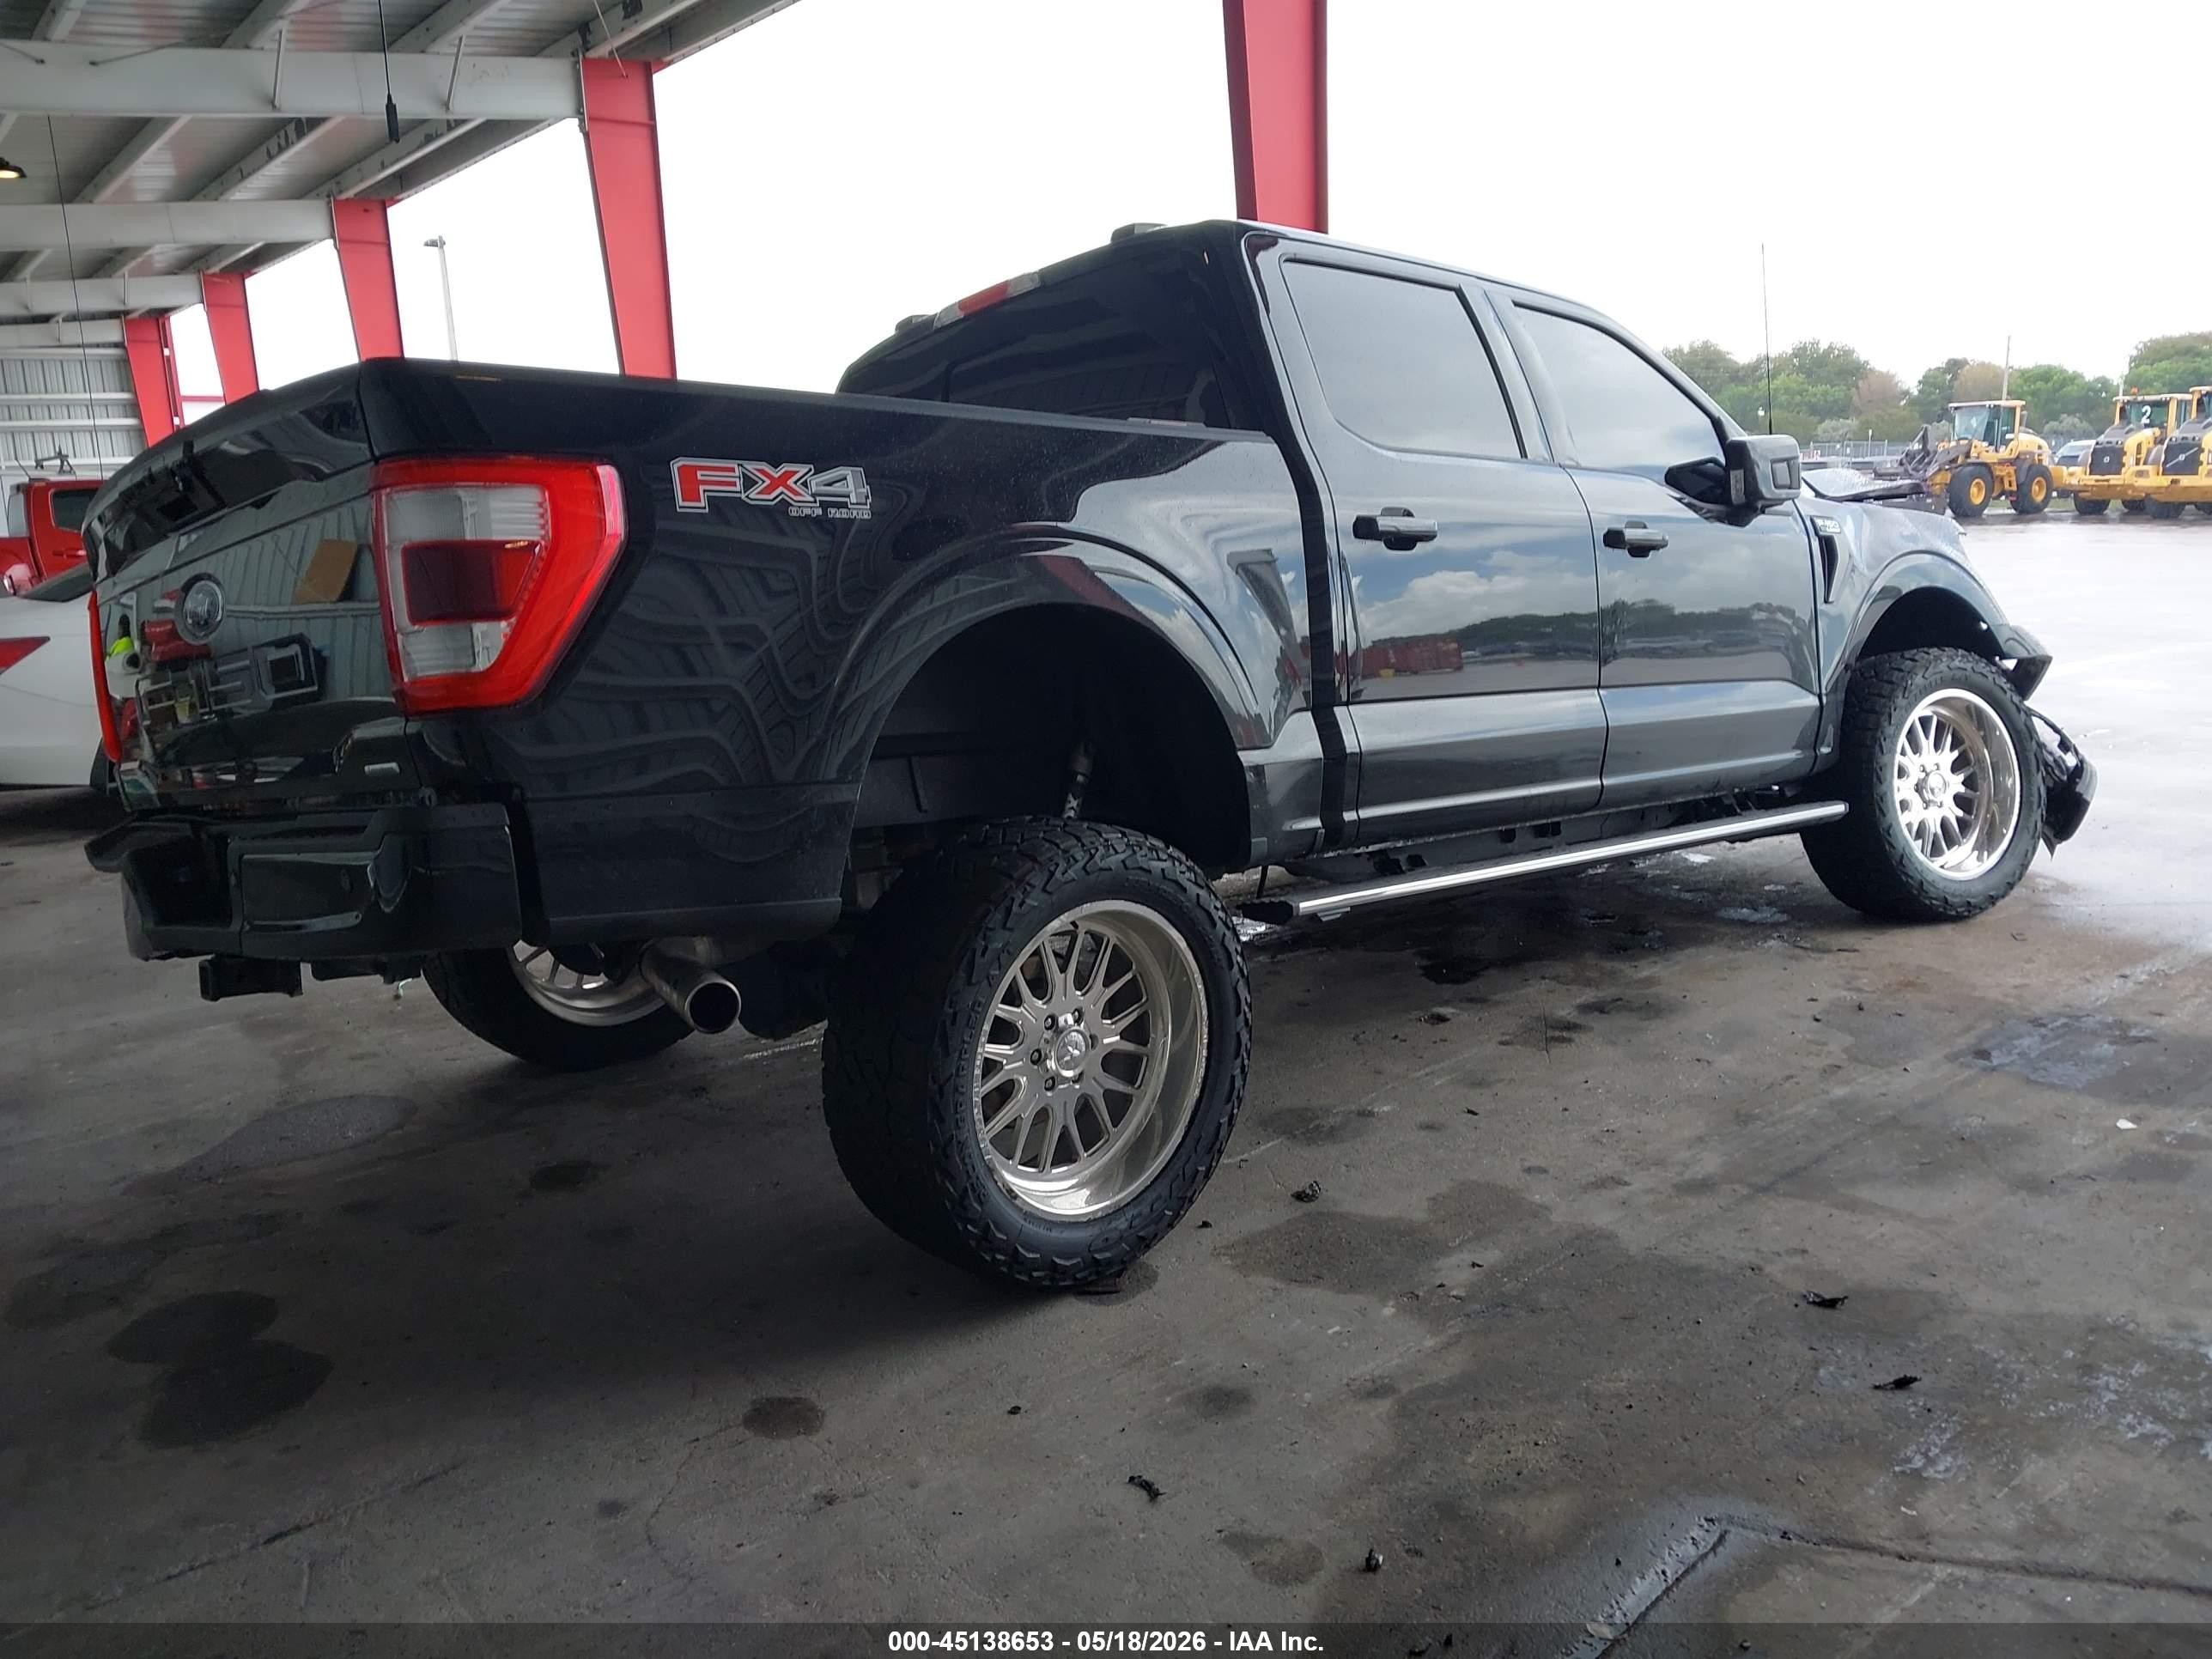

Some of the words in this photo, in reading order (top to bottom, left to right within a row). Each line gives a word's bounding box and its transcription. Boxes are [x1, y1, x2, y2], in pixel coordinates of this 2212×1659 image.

[2141, 405, 2152, 424] 2
[671, 457, 872, 513] FX4
[788, 507, 823, 517] OFF
